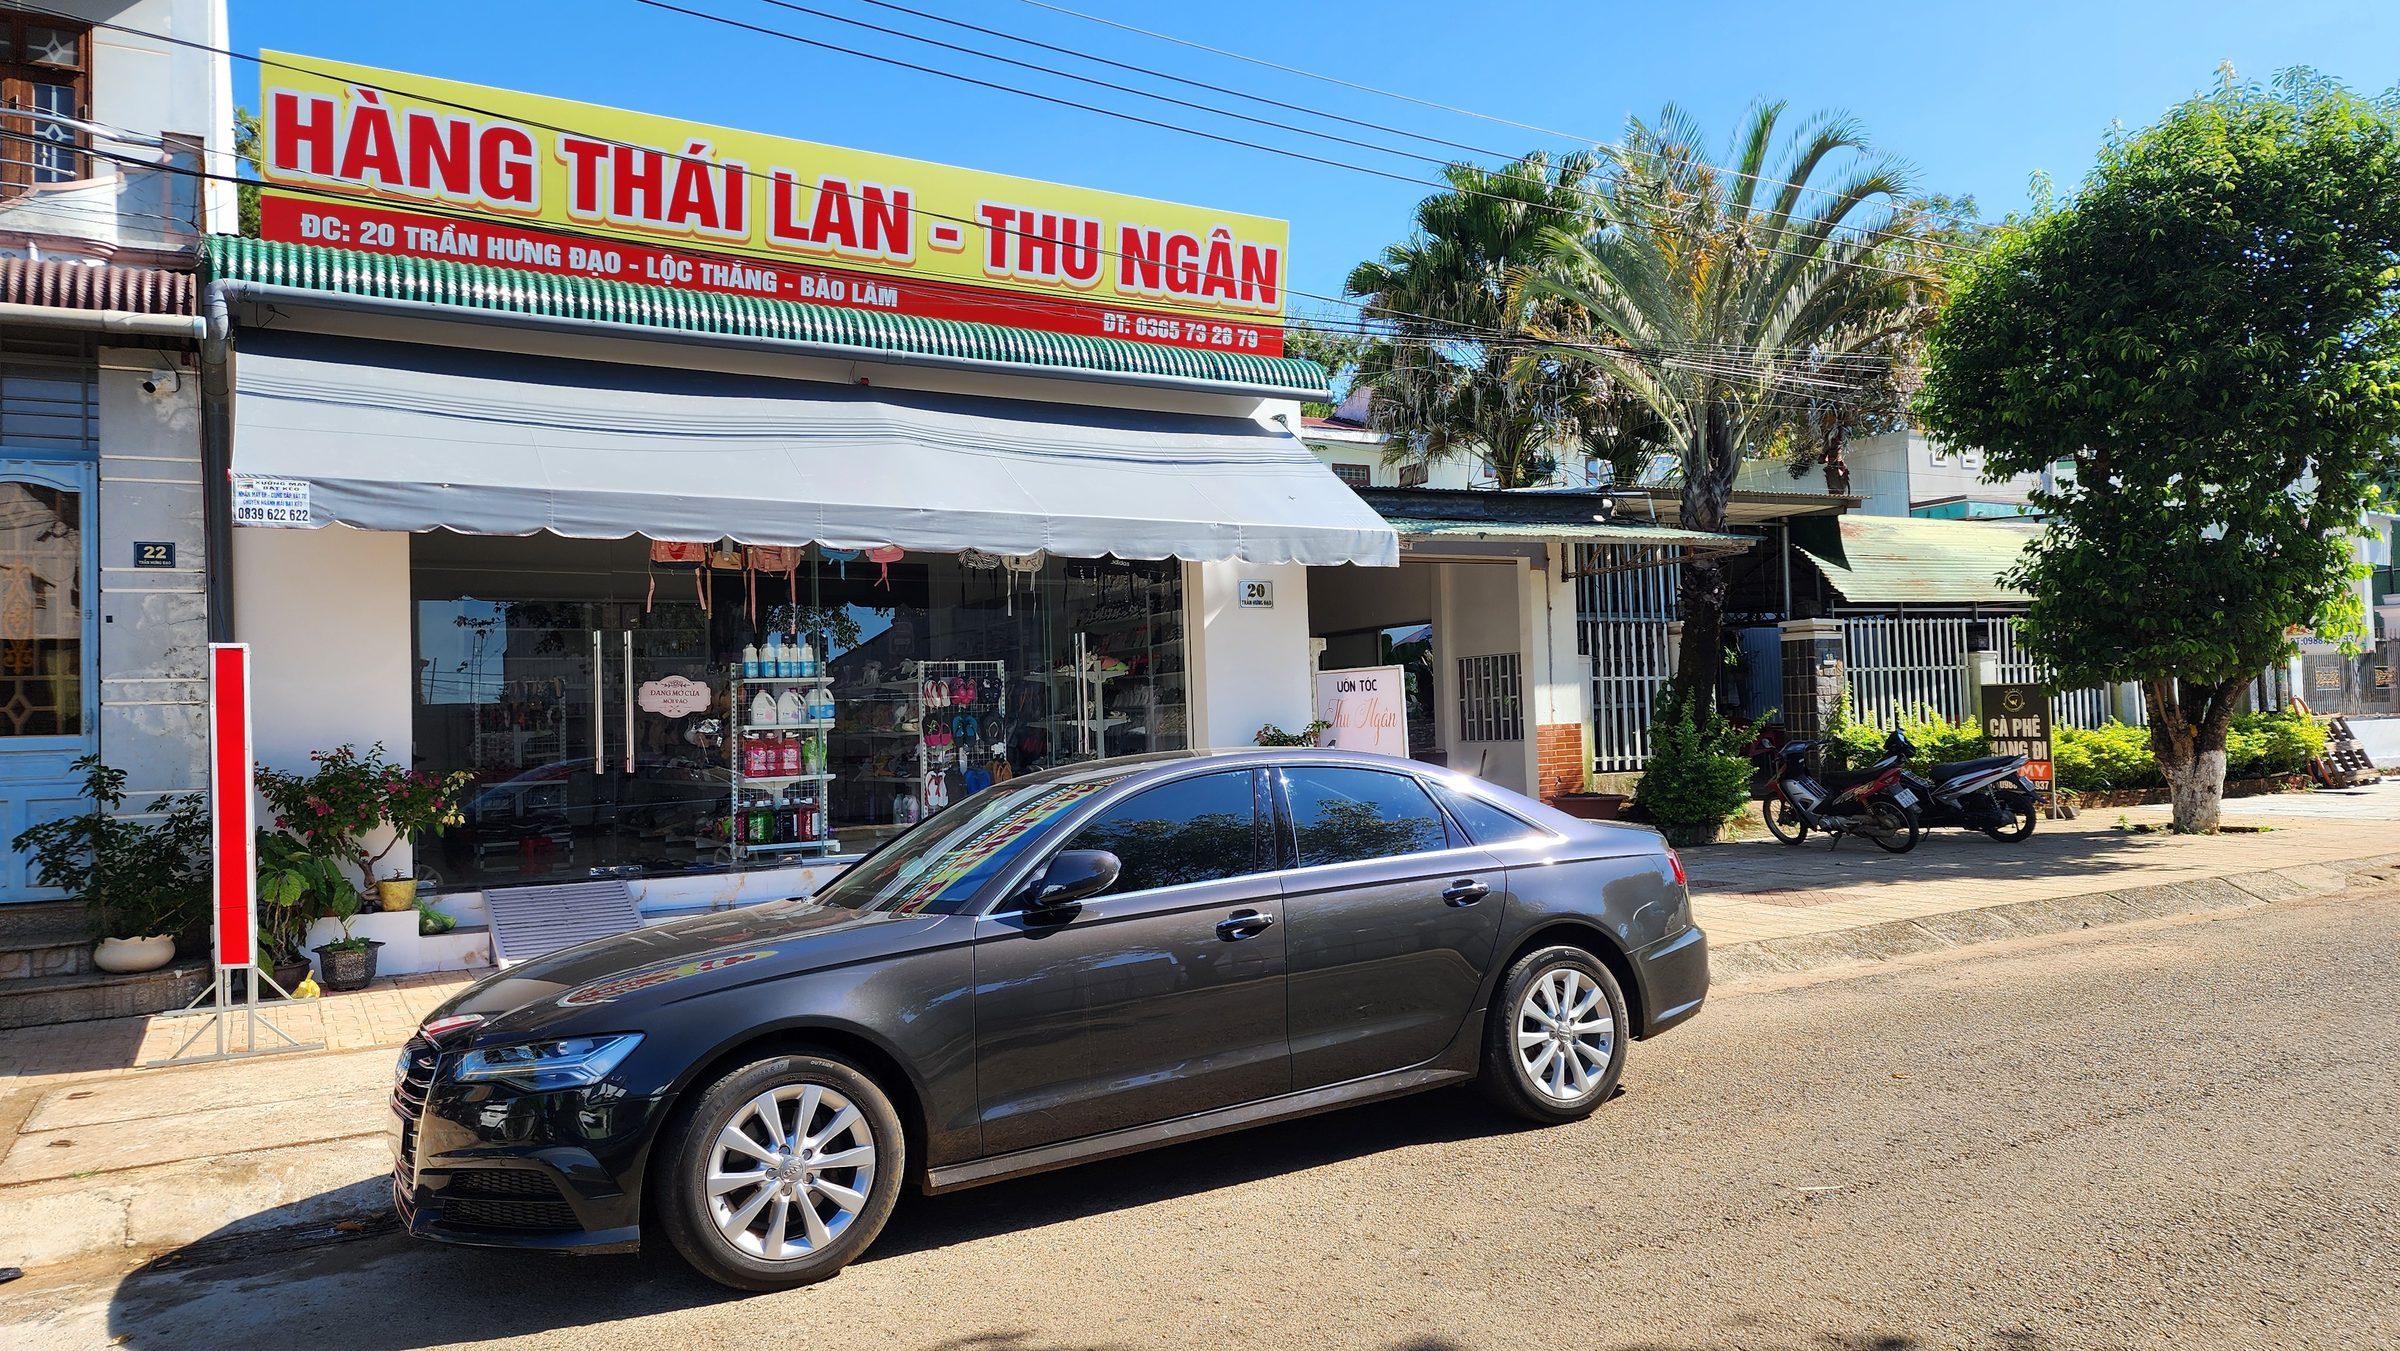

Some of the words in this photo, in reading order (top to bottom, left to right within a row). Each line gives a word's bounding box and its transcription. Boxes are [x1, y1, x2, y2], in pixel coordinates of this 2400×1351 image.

[275, 88, 533, 204] HÀNG
[563, 142, 744, 232] THÁI
[773, 171, 910, 256] LAN
[981, 204, 1100, 281] THU
[1120, 227, 1279, 304] NGÂN
[300, 213, 350, 242] ĐC:
[359, 221, 396, 247] 20
[403, 223, 478, 258] TRẦN
[486, 236, 562, 268] HƯNG
[568, 246, 622, 277] ĐẠO
[646, 253, 693, 285] LỘC
[800, 271, 845, 301] BẢO
[851, 280, 899, 308] LÂM
[1103, 312, 1131, 334] ĐT:
[1135, 316, 1181, 341] 0365
[1185, 322, 1207, 343] 73
[1211, 325, 1233, 346] 28
[1237, 328, 1259, 349] 79
[238, 507, 264, 520] 0839
[267, 508, 287, 521] 622
[289, 509, 309, 521] 622
[143, 545, 167, 559] 22
[1247, 583, 1266, 598] 20
[1336, 675, 1356, 693] UỐN
[1359, 675, 1378, 692] TÓC
[1989, 714, 2010, 738] CÀ
[2012, 713, 2042, 738] PHÊ
[2031, 740, 2048, 760] ĐI
[810, 1060, 835, 1069] OUTSIDE
